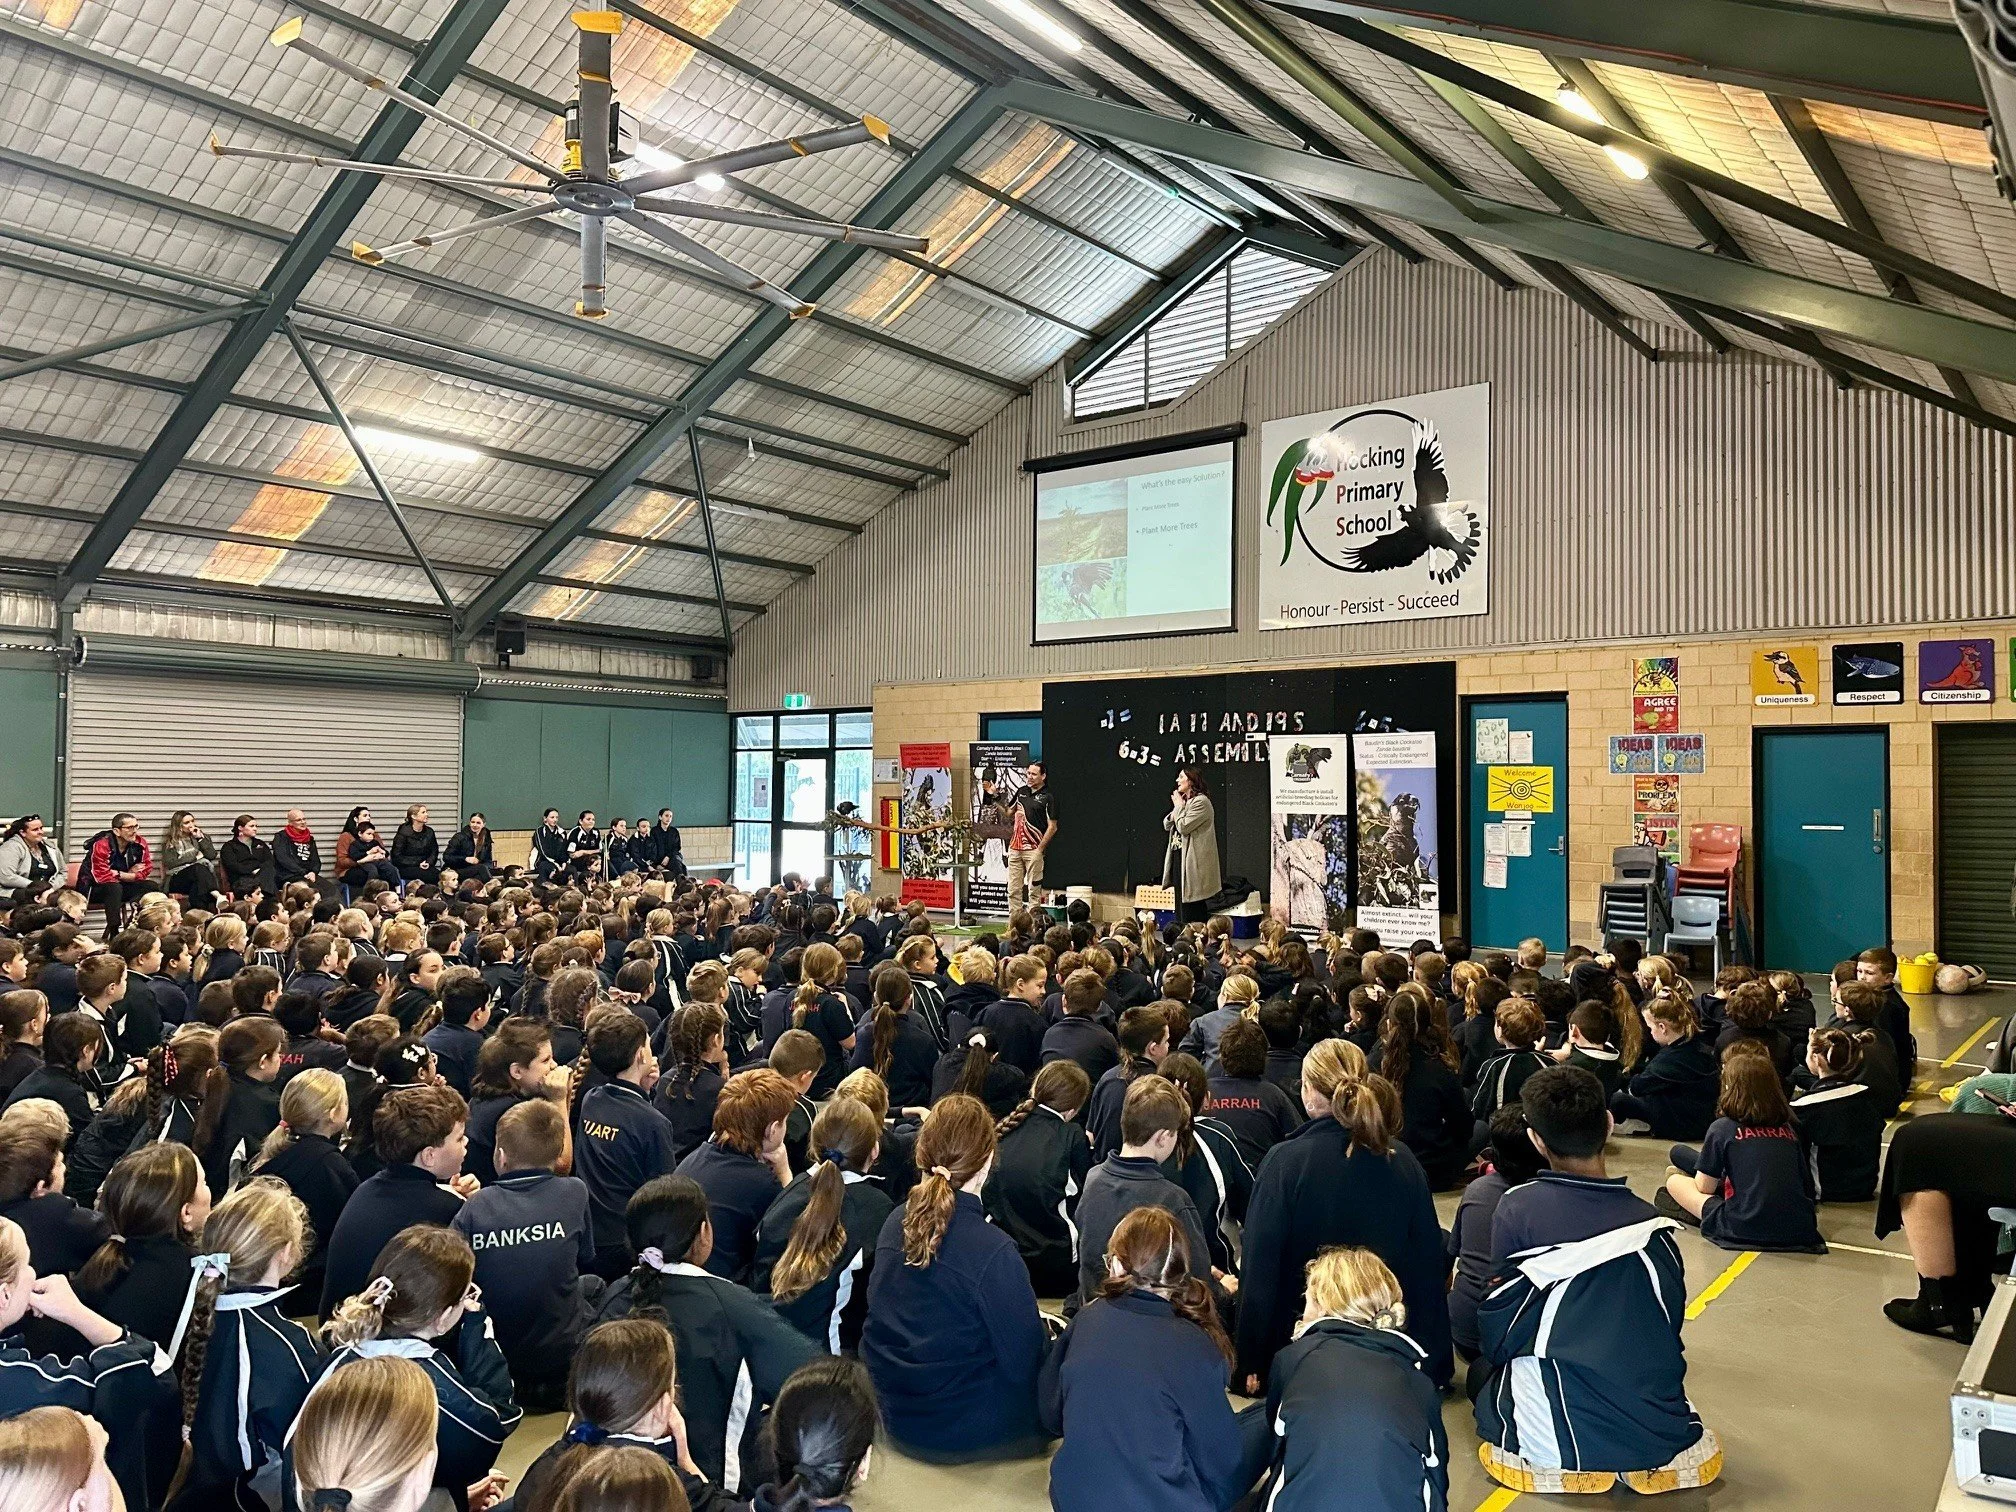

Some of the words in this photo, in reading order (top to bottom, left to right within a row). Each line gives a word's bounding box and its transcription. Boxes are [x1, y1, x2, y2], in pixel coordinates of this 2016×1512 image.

[1336, 446, 1404, 472] Hocking
[1141, 480, 1164, 490] What's
[1177, 477, 1192, 486] easy
[1336, 481, 1404, 504] Primary
[1141, 526, 1159, 535] Plant
[1160, 524, 1178, 533] More
[1180, 521, 1198, 530] Trees
[1336, 509, 1391, 537] School
[1280, 604, 1330, 620] Honour
[1340, 597, 1385, 615] Persist
[1397, 589, 1460, 611] Succeed
[1644, 697, 1677, 707] AGREE
[1760, 695, 1809, 705] Uniqueness
[1850, 692, 1886, 702] Respect
[1930, 691, 1982, 702] Citizenship
[1219, 712, 1259, 732] AND
[1618, 738, 1653, 751] IDEAS
[1665, 737, 1701, 751] IDEAS
[1504, 769, 1537, 777] Welcome
[1638, 791, 1677, 799] PROBLEM
[1645, 819, 1678, 828] LISTEN
[583, 1119, 619, 1141] UART
[472, 1221, 566, 1251] BANKSIA
